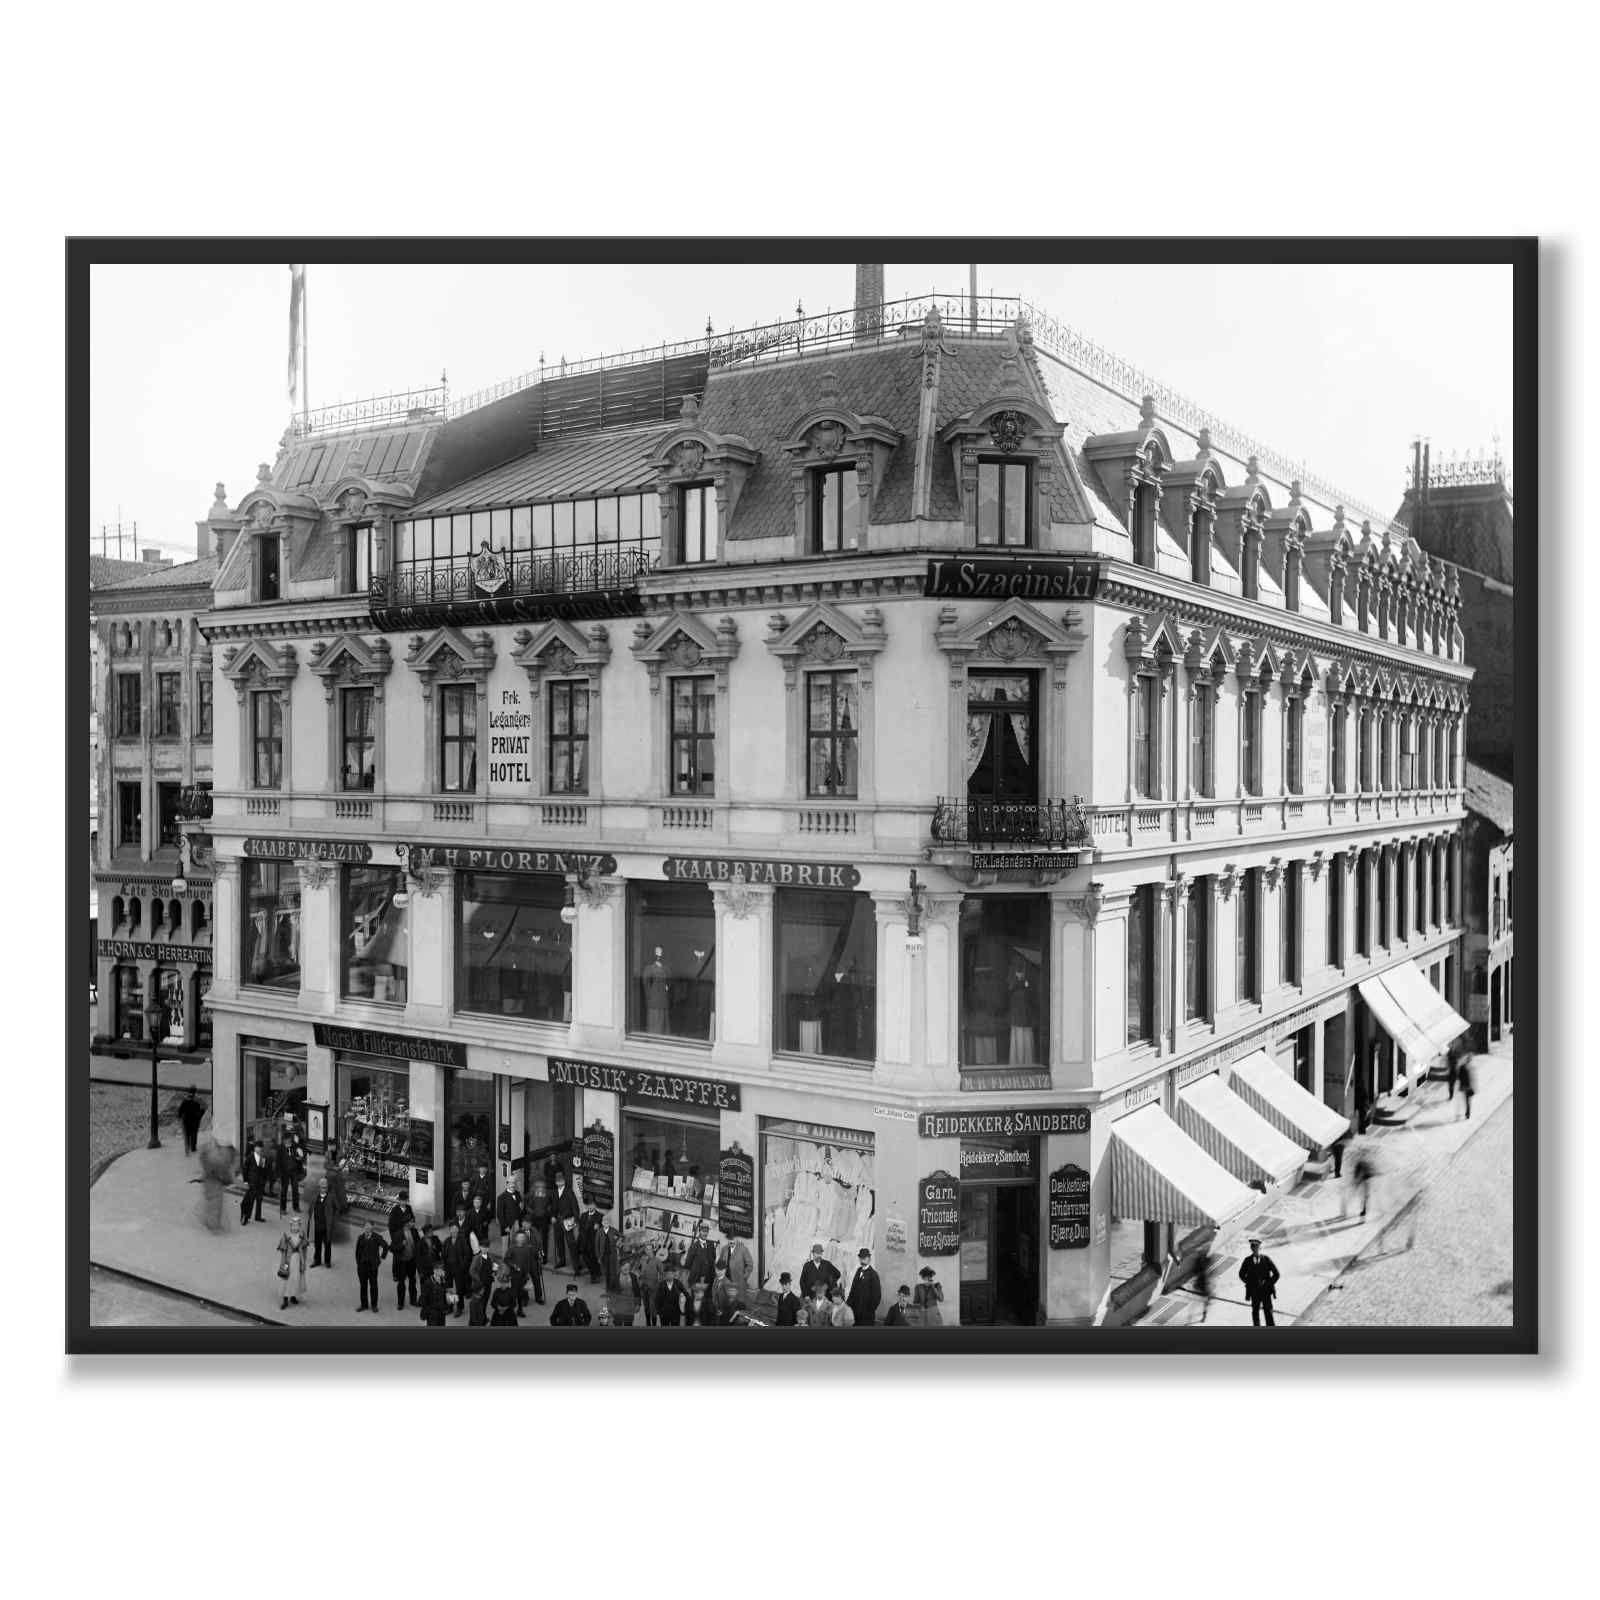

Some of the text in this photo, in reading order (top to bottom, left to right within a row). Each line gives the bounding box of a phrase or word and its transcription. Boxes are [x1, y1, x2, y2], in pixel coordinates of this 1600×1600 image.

[958, 563, 1093, 597] Szacinski
[502, 691, 521, 705] Frk.
[489, 711, 531, 730] Legangers
[491, 737, 530, 754] PRIVAT
[490, 762, 531, 782] HOTEL
[1094, 813, 1126, 834] HOTEL
[469, 850, 603, 873] FLORENTZ
[107, 942, 136, 960] HORN
[555, 1061, 730, 1108] MUSIK ZAPFFE
[1014, 1112, 1086, 1132] SANDBERG
[925, 1185, 957, 1200] Garn.
[920, 1208, 958, 1225] Tricotage
